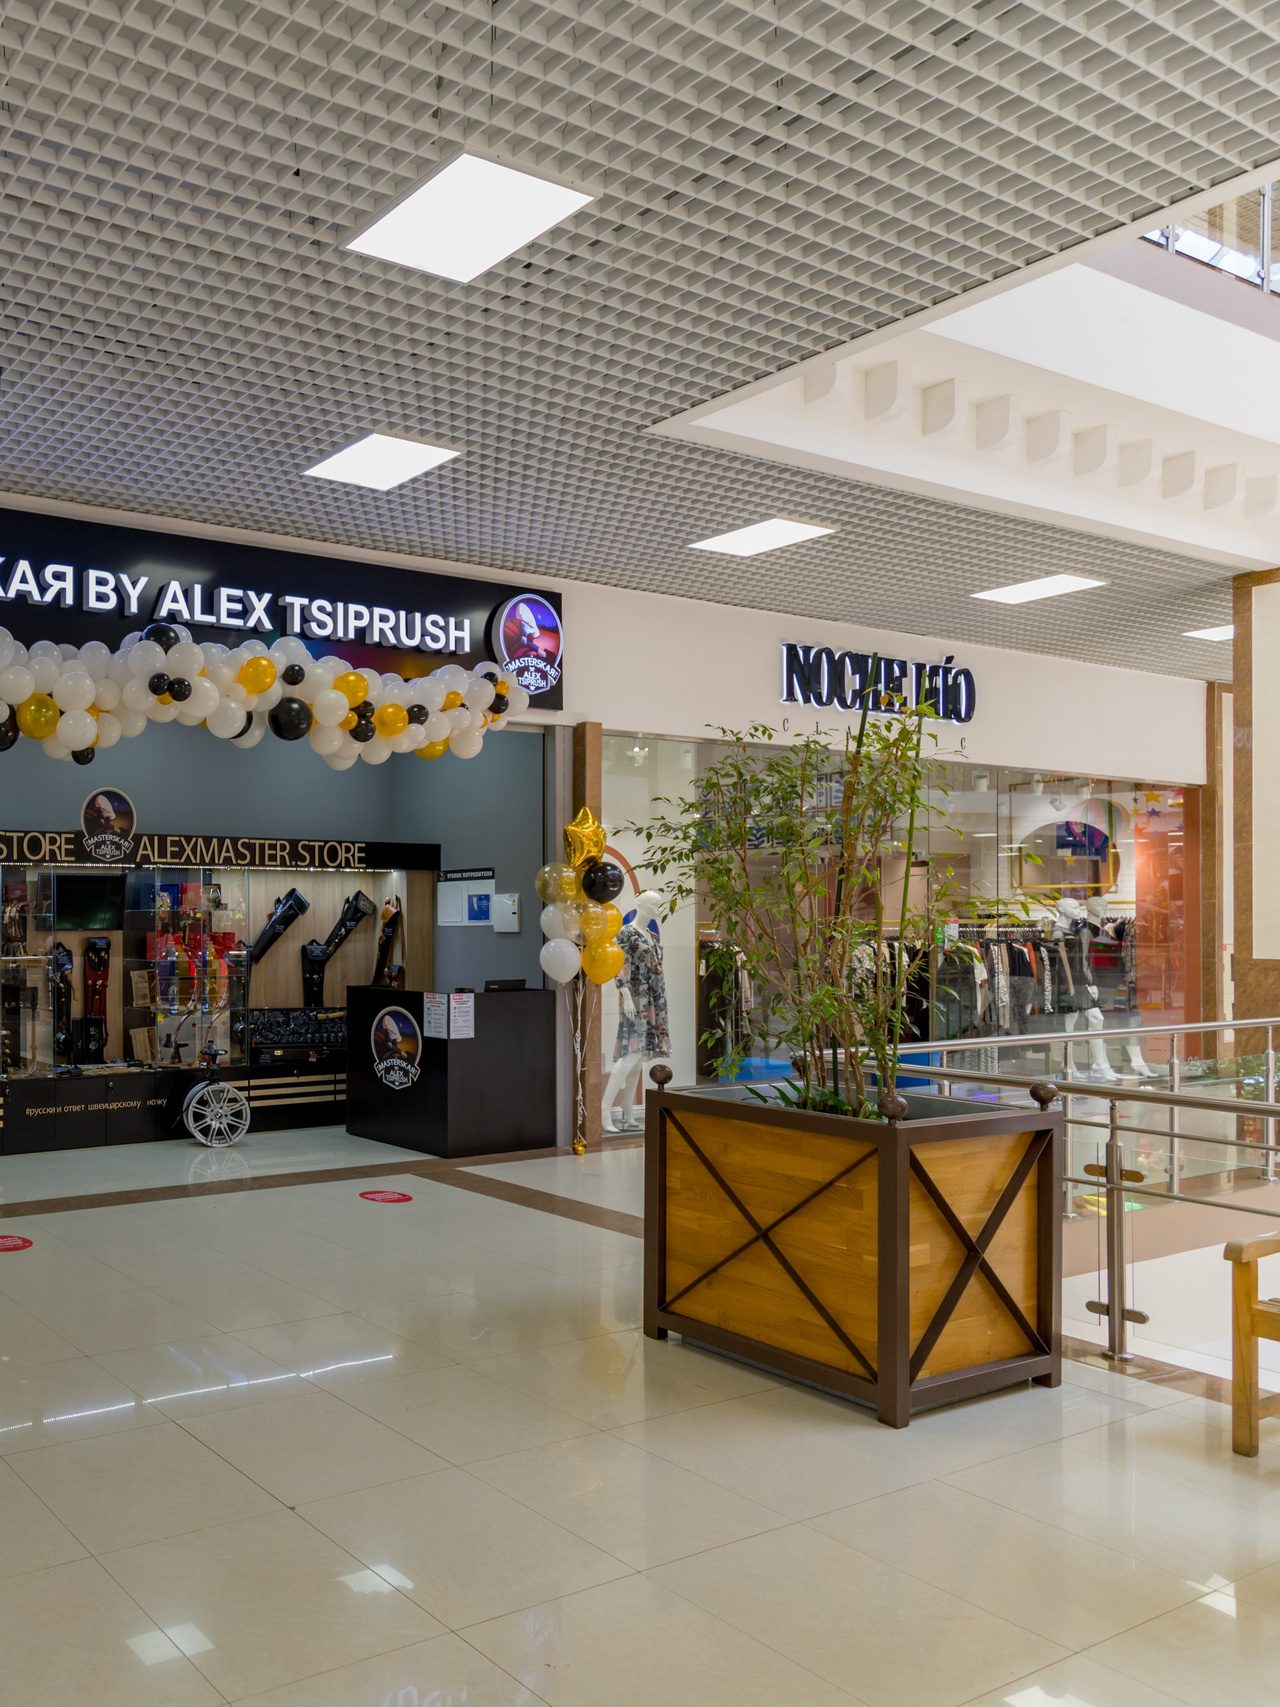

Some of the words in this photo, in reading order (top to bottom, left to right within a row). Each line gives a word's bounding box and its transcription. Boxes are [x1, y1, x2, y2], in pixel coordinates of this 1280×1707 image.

[85, 568, 149, 616] BY
[157, 580, 273, 632] ALEX
[282, 595, 471, 654] TSIPRUSH
[518, 676, 546, 688] TSIPRUSH
[523, 670, 541, 680] ALEX
[781, 643, 908, 715] NOCHE
[782, 718, 967, 750] CLAIC
[136, 836, 366, 868] ALEXMASTER.STORE
[63, 1104, 85, 1112] ответ
